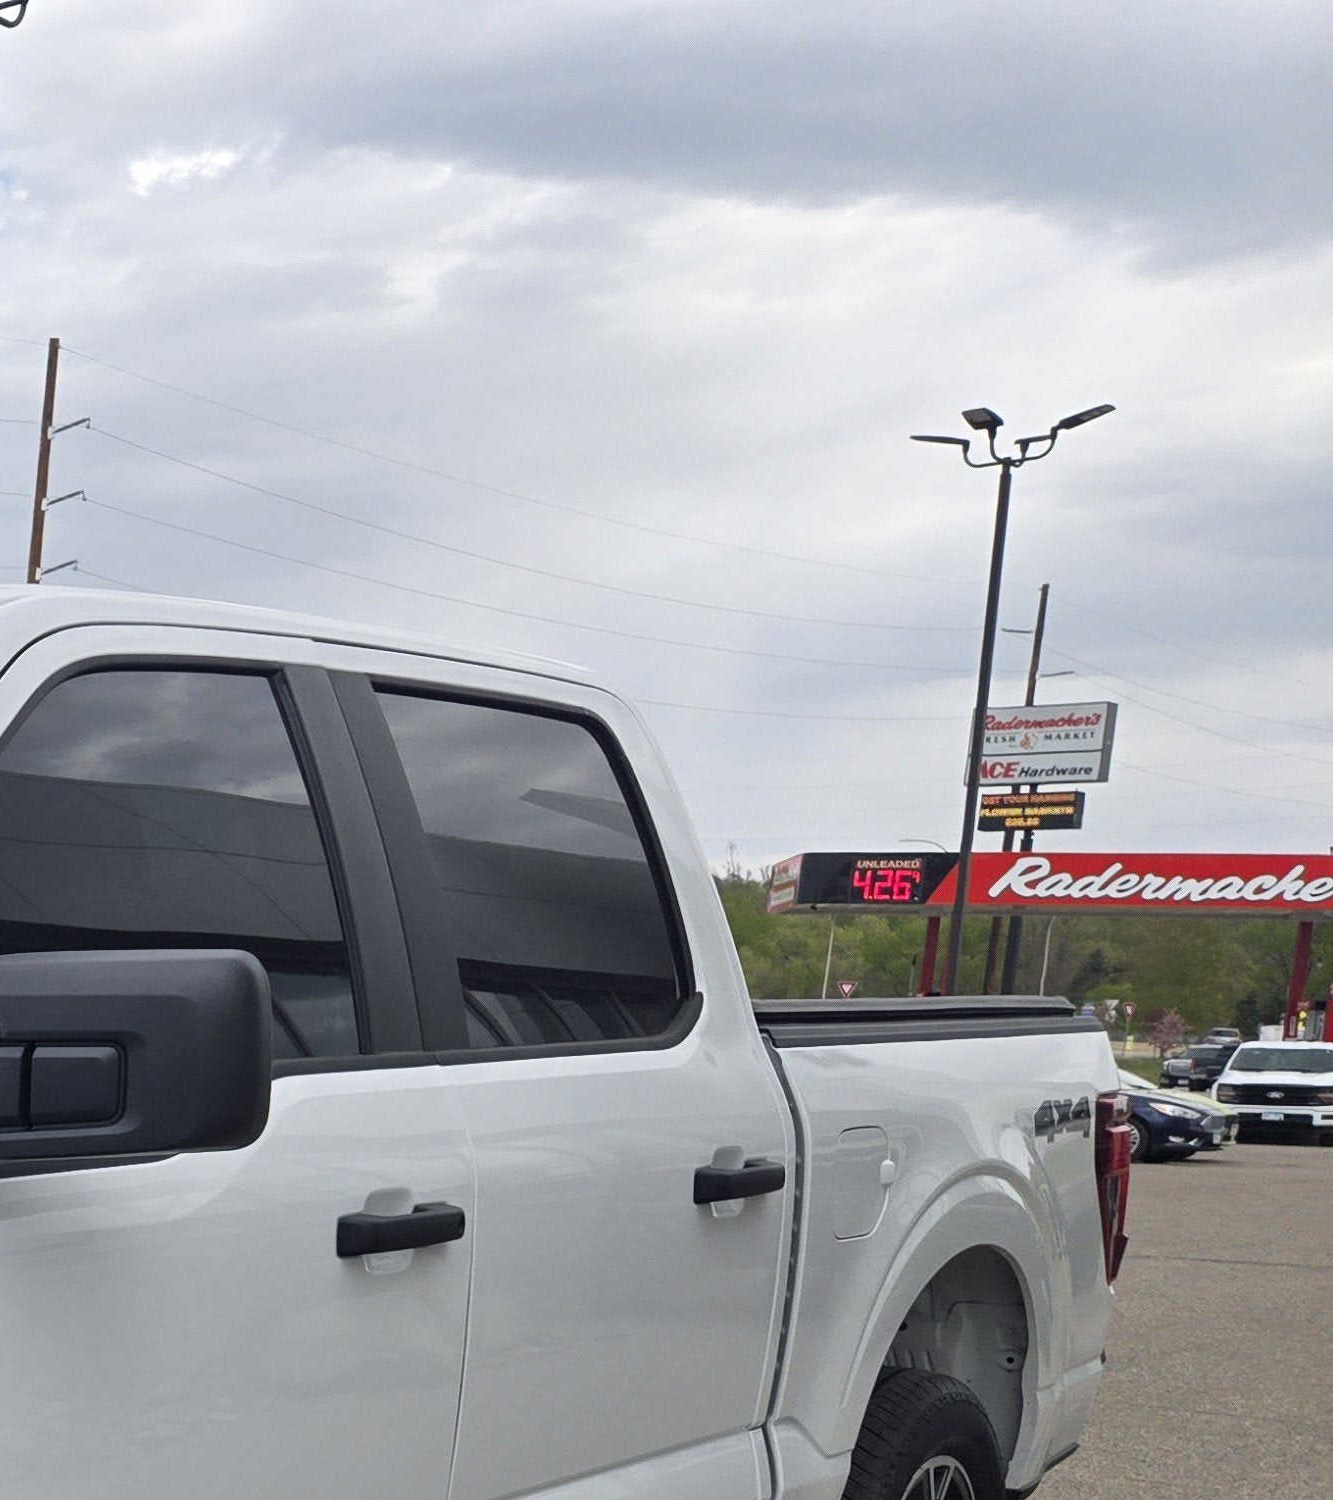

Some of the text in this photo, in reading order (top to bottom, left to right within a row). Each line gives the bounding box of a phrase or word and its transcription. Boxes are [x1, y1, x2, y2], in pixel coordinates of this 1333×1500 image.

[985, 731, 1095, 744] RESH MARKET
[1018, 765, 1093, 778] Hardware
[857, 859, 920, 868] UNLEADED
